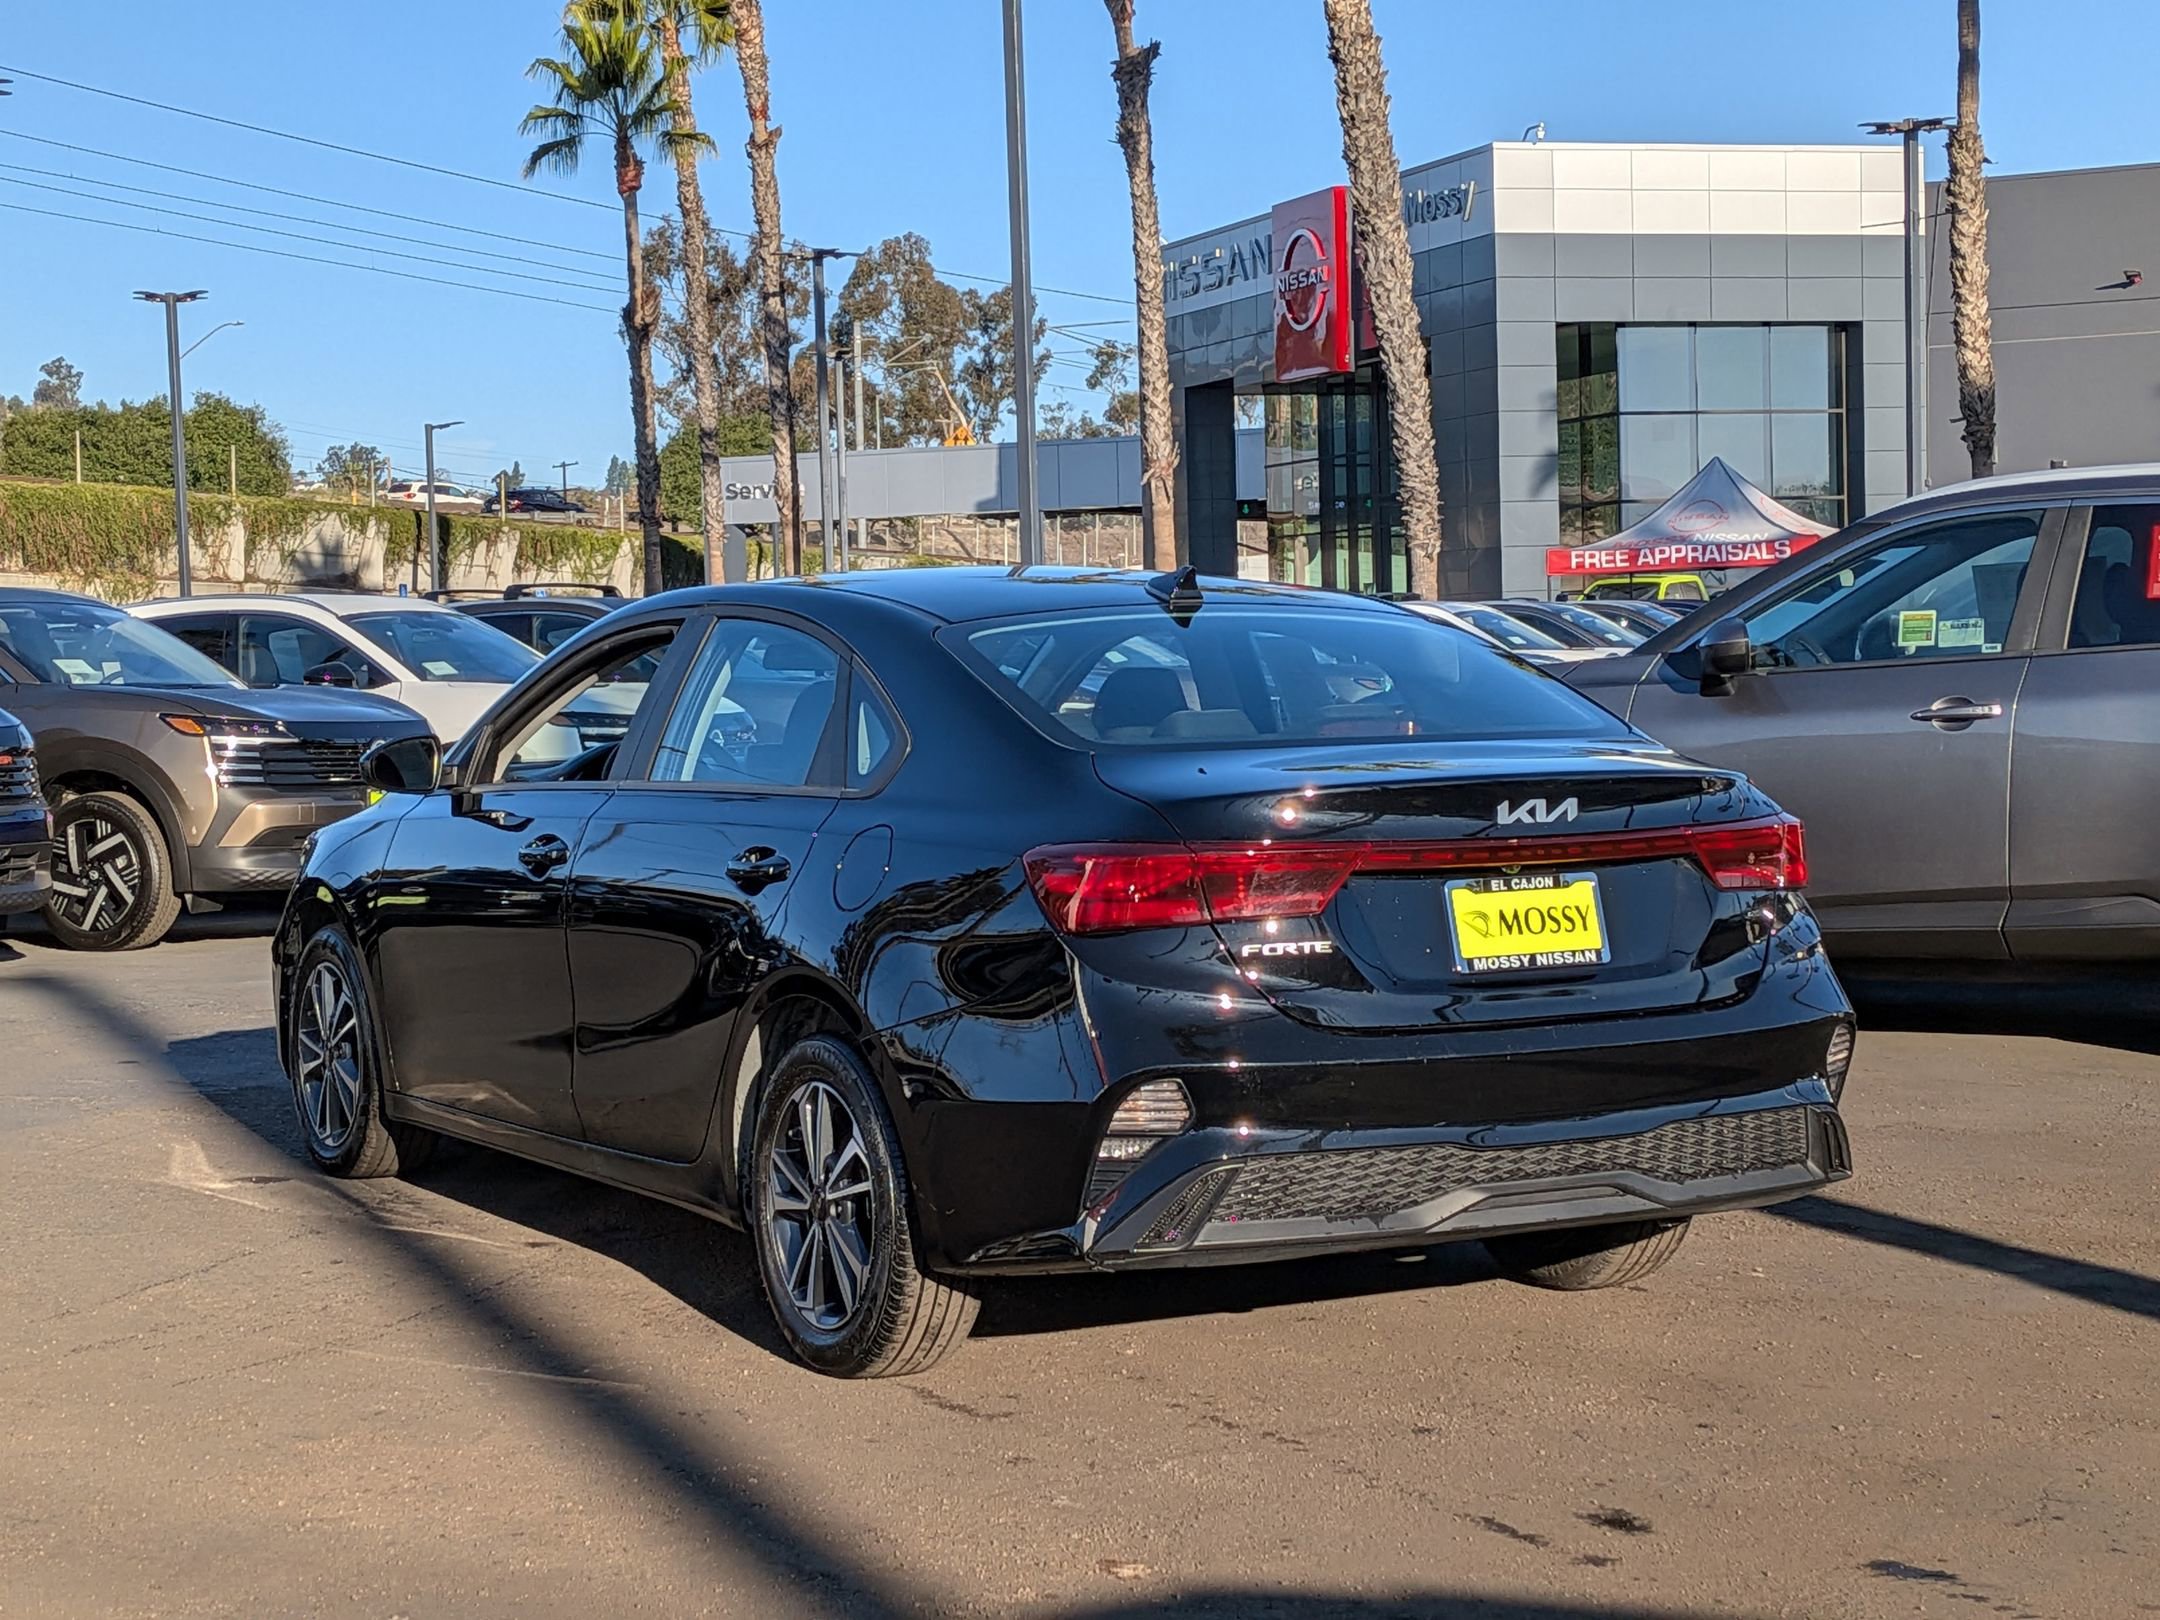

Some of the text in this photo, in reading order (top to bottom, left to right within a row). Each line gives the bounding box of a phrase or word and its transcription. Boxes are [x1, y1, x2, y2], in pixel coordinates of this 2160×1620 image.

[1405, 180, 1475, 228] Mossy
[1160, 234, 1273, 303] ISSAN
[1277, 265, 1330, 292] NISSAN
[1693, 532, 1769, 542] NISSAN
[1570, 540, 1792, 569] FREE APPRAISALS
[1496, 797, 1579, 825] KIA
[1490, 877, 1554, 891] EL CAJON
[1499, 904, 1590, 936] MOSSY
[1241, 940, 1333, 957] FORTE
[1473, 950, 1597, 971] MOSSY NISSAN
